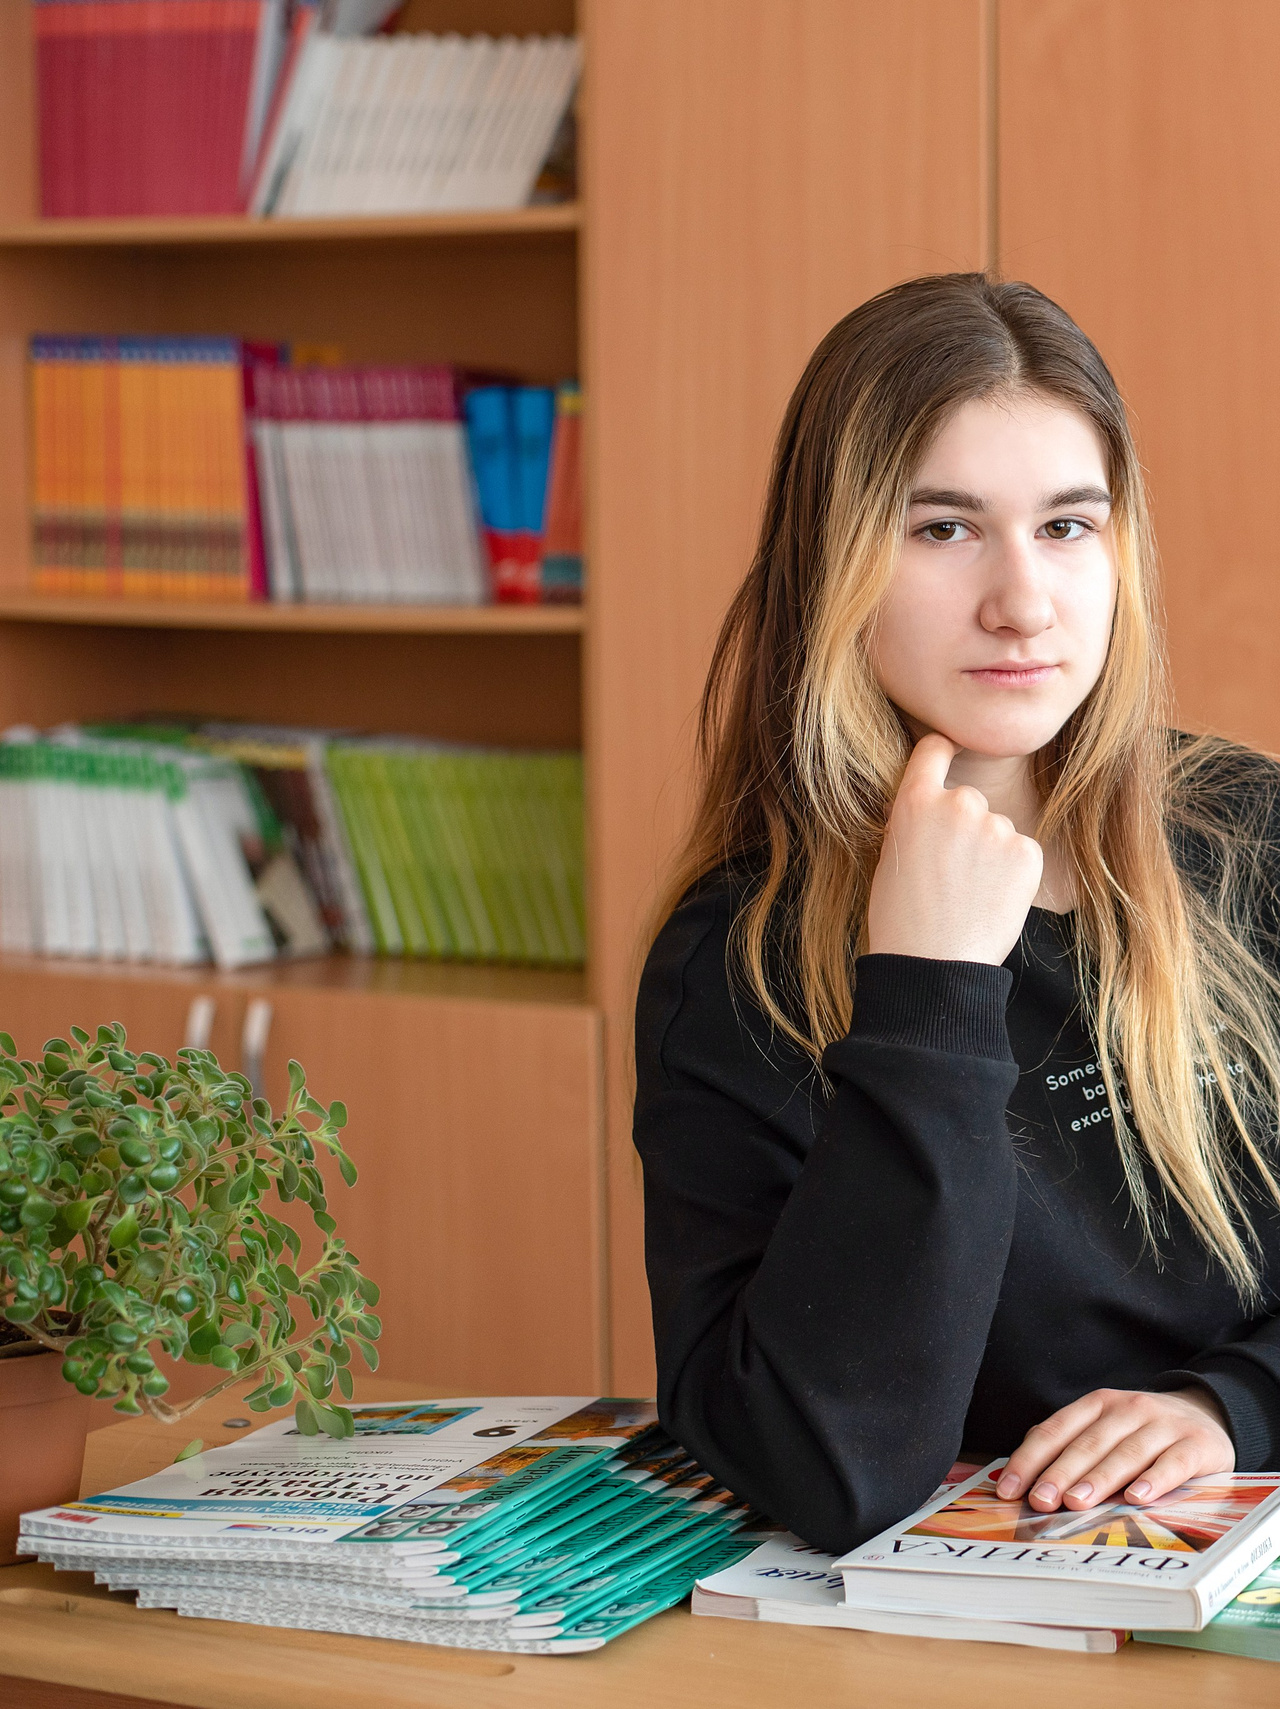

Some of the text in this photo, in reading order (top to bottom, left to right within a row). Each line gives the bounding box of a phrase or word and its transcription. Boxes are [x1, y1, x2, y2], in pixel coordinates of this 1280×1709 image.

[473, 1426, 522, 1438] 9
[208, 1469, 436, 1481] по литературе
[479, 1446, 604, 1503] Литература
[230, 1478, 412, 1493] тетрадь
[197, 1488, 400, 1504] Рабочая
[98, 1500, 367, 1516] УНИВЕРСАЛЬНЫЕ УЧЕБНЫЕ
[270, 1501, 379, 1511] ДЕЙСТВИЯ
[891, 1539, 1190, 1571] ФИЗИКА
